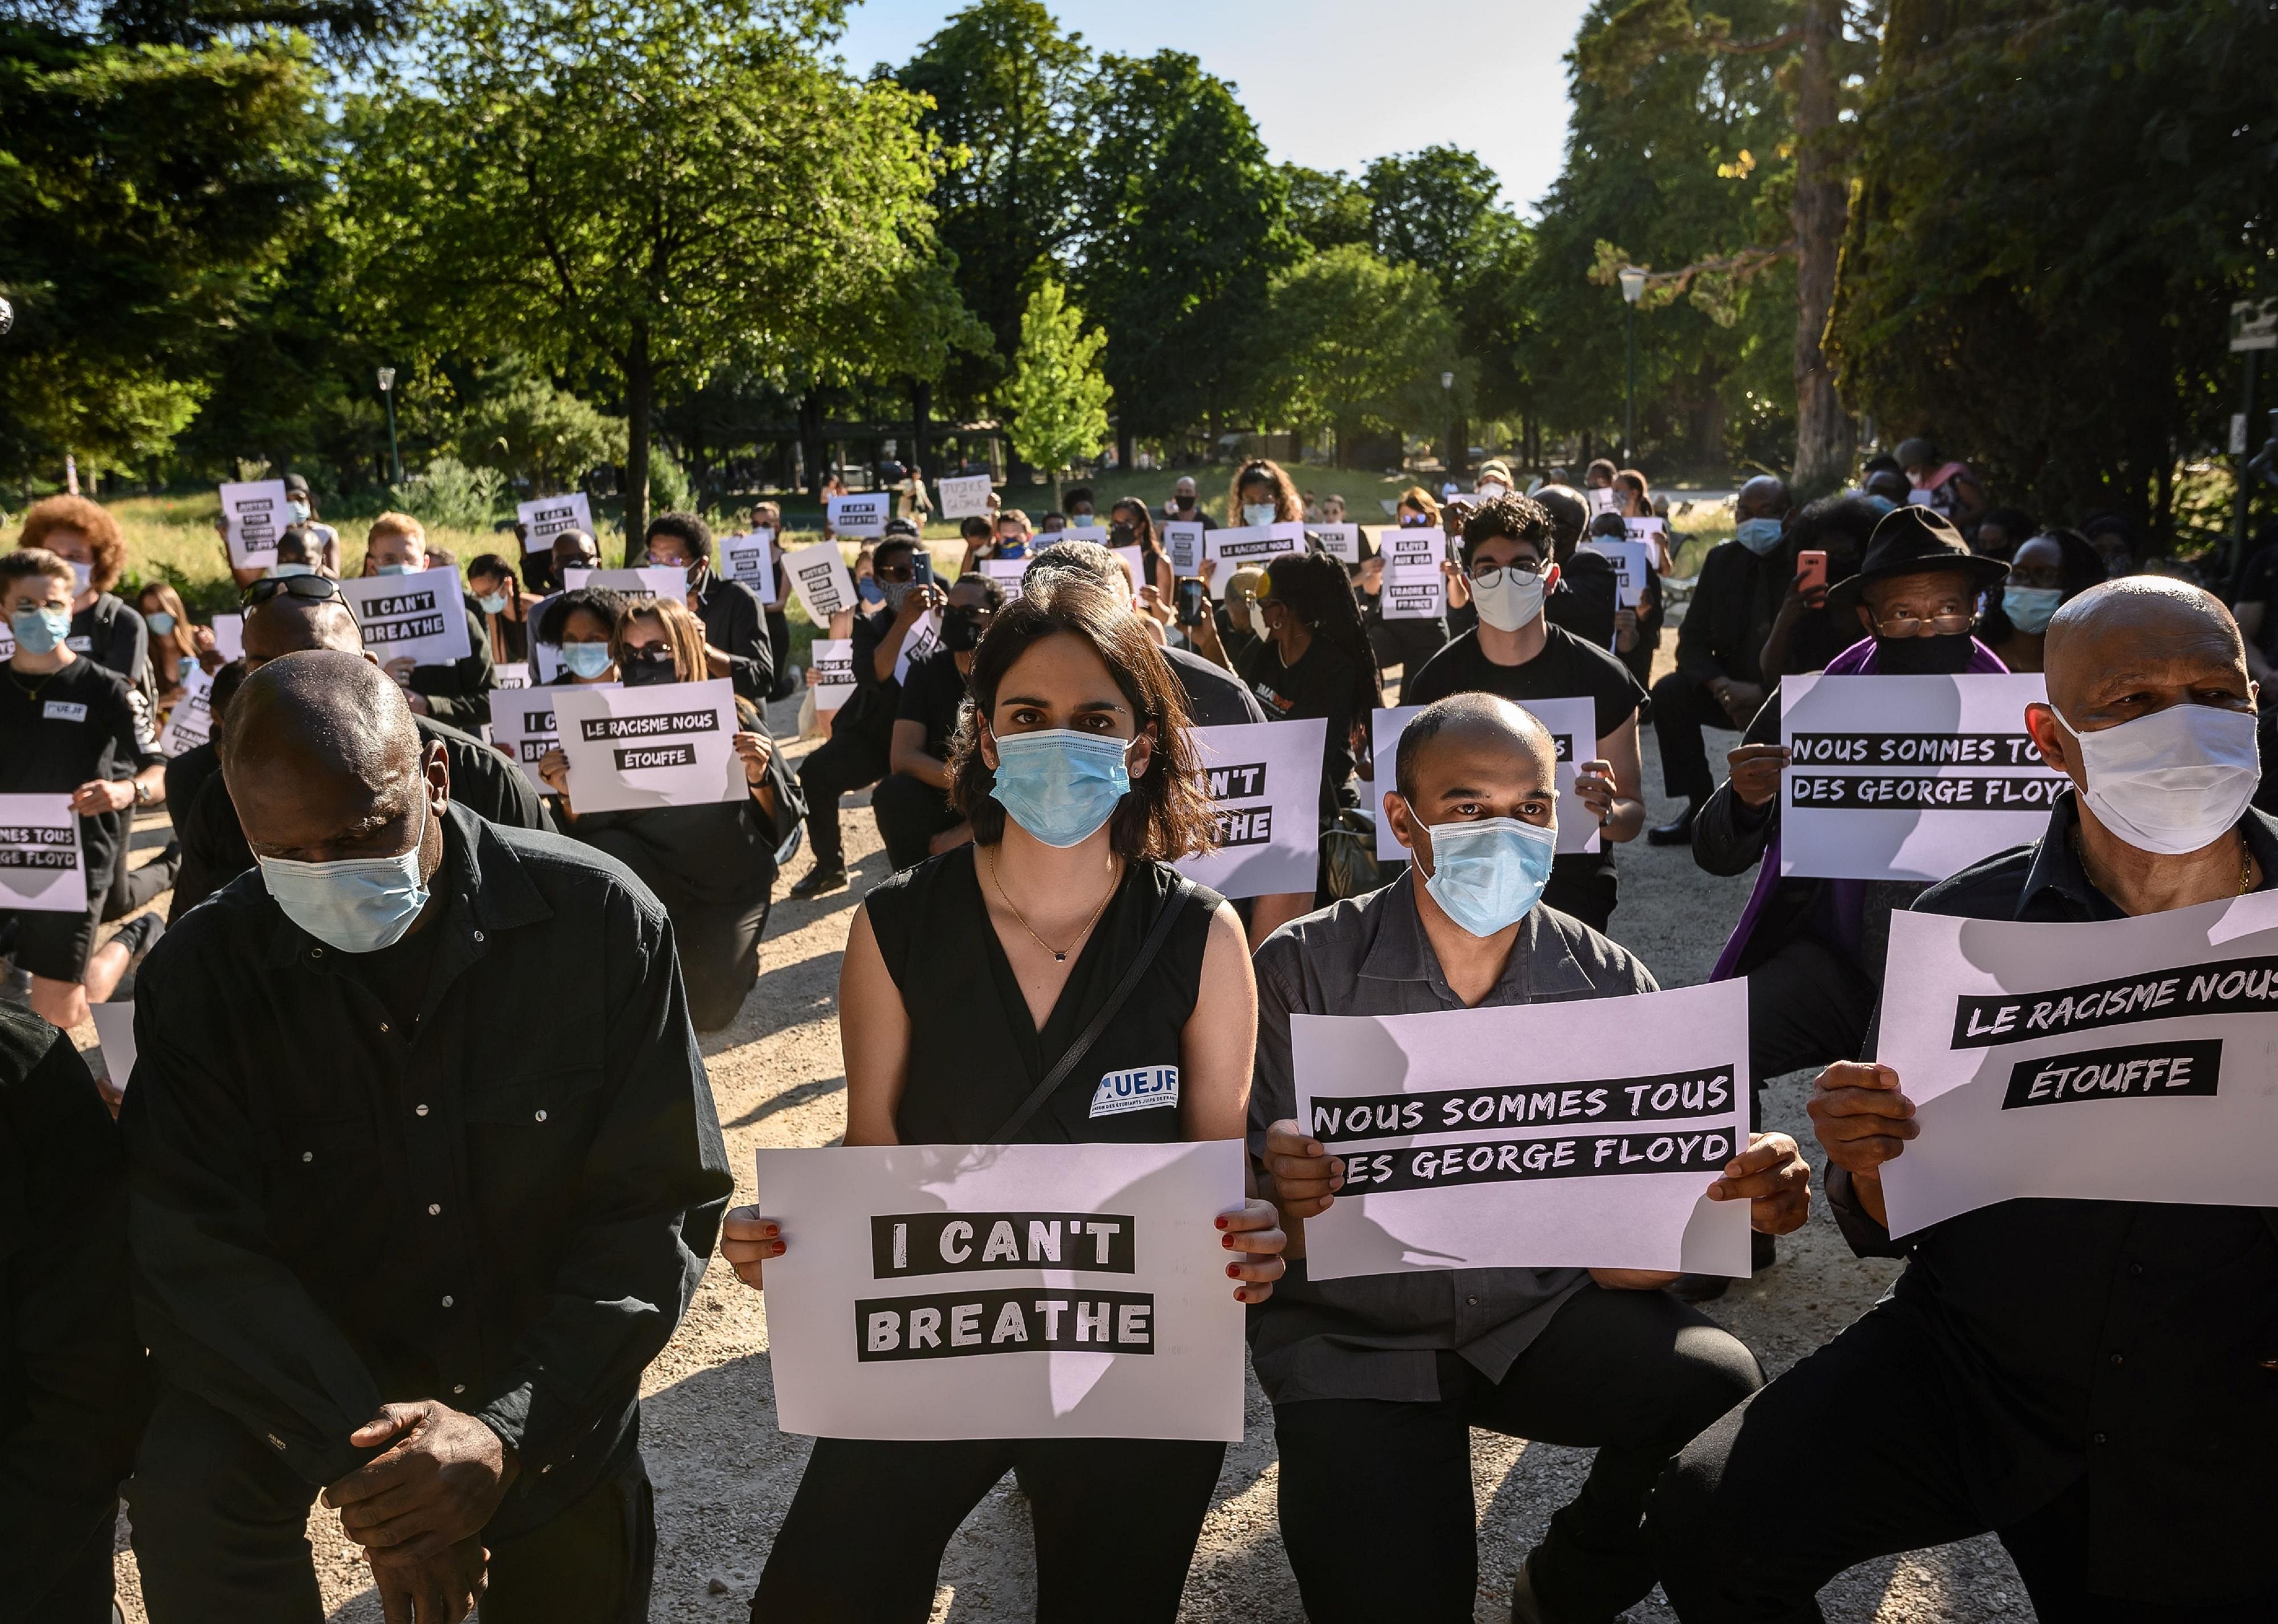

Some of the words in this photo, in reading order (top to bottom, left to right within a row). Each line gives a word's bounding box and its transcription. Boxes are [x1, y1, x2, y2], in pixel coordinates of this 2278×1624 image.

[367, 601, 373, 615] I
[380, 594, 430, 614] CAN'T
[364, 617, 443, 642] BREATHE
[530, 714, 535, 731] I
[586, 722, 605, 737] LE
[609, 717, 669, 736] RACISME
[673, 713, 712, 729] NOUS
[624, 749, 686, 768] ÉTOUFFE
[1793, 738, 1868, 761] NOUS
[1880, 738, 1995, 762] SOMMES
[2006, 738, 2041, 763] TO
[1794, 779, 1845, 801] DES
[1857, 780, 1973, 804] GEORGE
[33, 829, 73, 844] TOUS
[27, 851, 75, 866] FLOYD
[1966, 1006, 2020, 1037] LE
[2026, 978, 2180, 1030] RACISME
[1115, 1070, 1176, 1096] UEJF
[2028, 1058, 2194, 1100] ÉTOUFFE
[1314, 1101, 1424, 1135] NOUS
[1442, 1089, 1608, 1126] SOMMES
[1624, 1075, 1729, 1116] TOUS
[1347, 1154, 1393, 1184] ES
[1412, 1141, 1576, 1180] GEORGE
[1594, 1135, 1729, 1167] FLOYD
[894, 1223, 907, 1268] I
[939, 1221, 1120, 1264] CAN'T
[867, 1300, 1151, 1352] BREATHE
